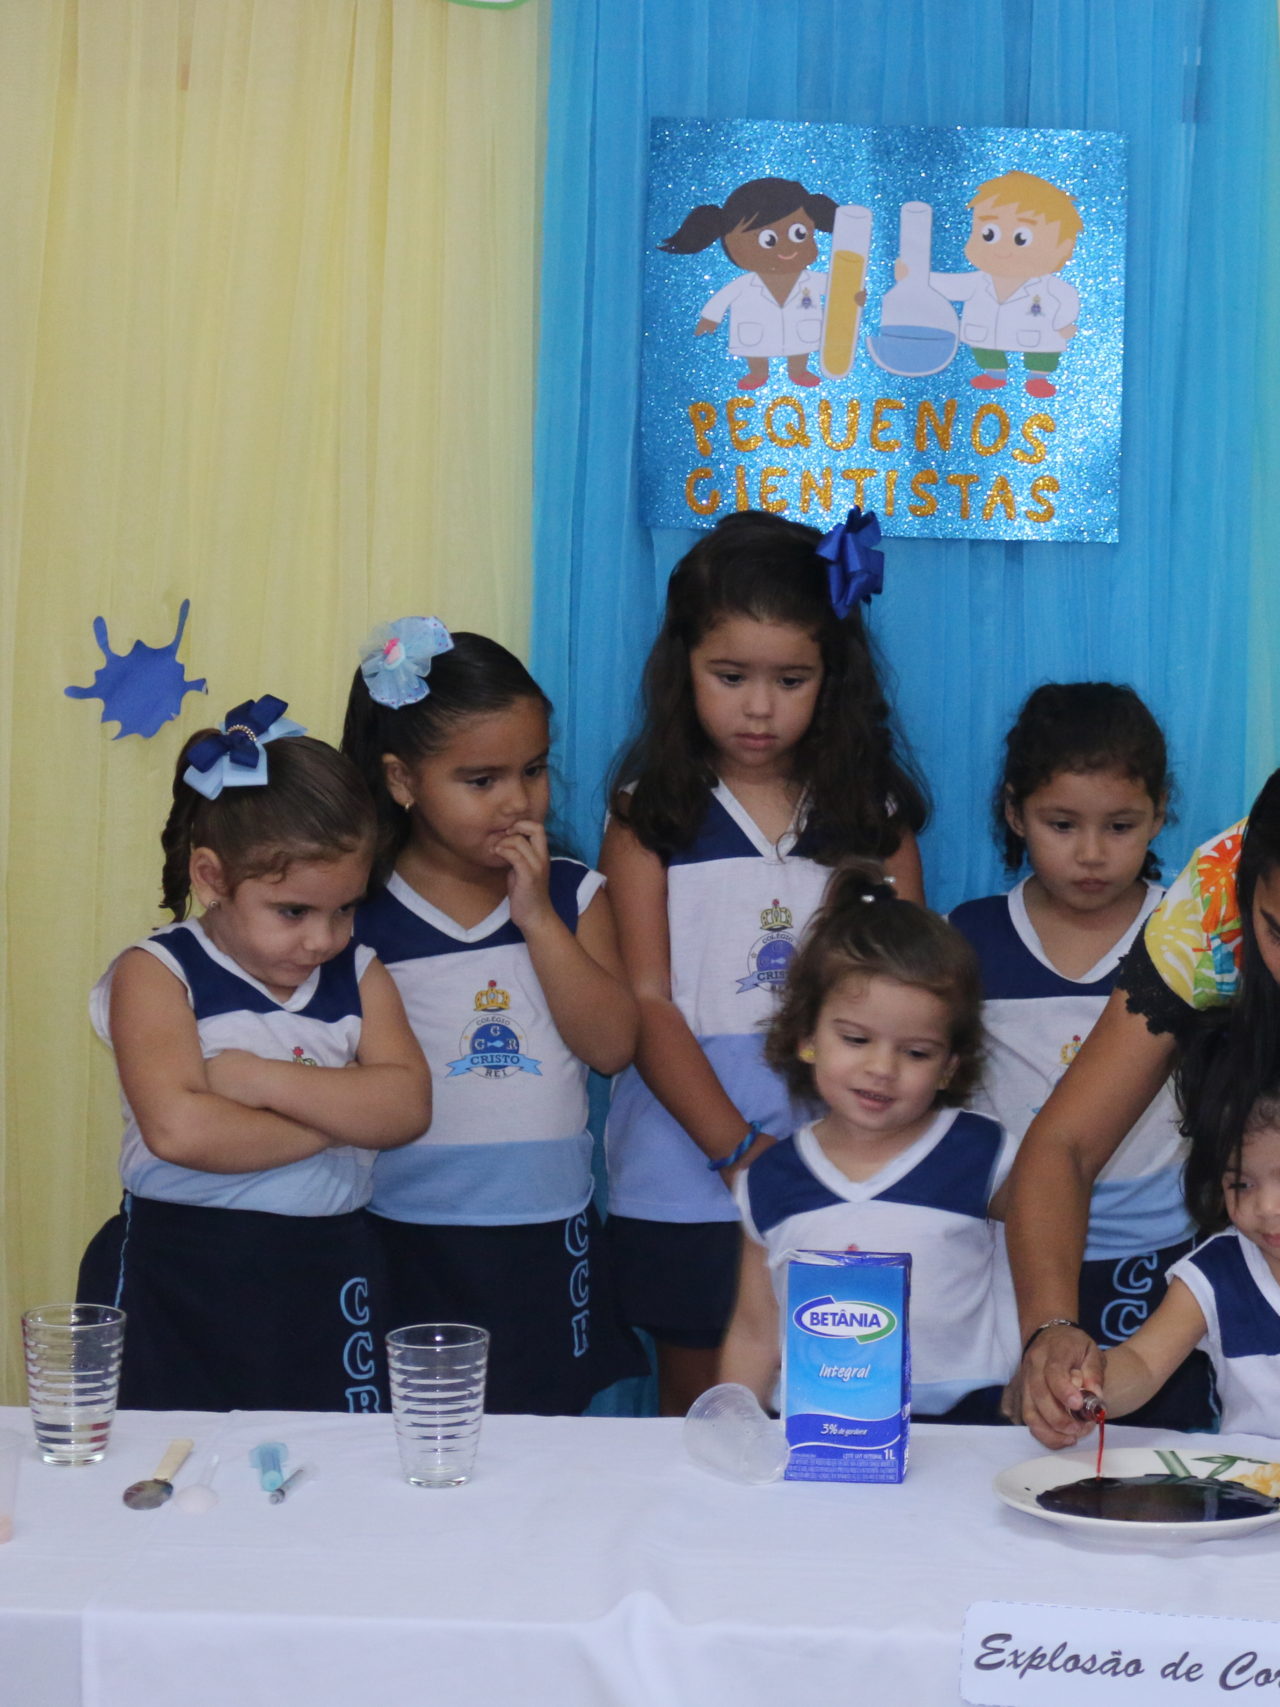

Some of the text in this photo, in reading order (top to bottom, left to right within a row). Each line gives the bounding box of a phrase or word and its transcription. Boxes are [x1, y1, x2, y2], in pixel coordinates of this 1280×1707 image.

[687, 395, 1056, 465] PEQUENOS
[685, 464, 1060, 523] CIENTISTAS
[757, 970, 785, 981] CRIS
[470, 1054, 520, 1065] CRISTO
[485, 1068, 507, 1077] REI
[809, 1308, 881, 1328] BETÂNIA
[819, 1363, 871, 1382] Integral
[883, 1448, 896, 1460] 1L
[974, 1632, 1145, 1679] Explosão
[1160, 1651, 1204, 1683] de
